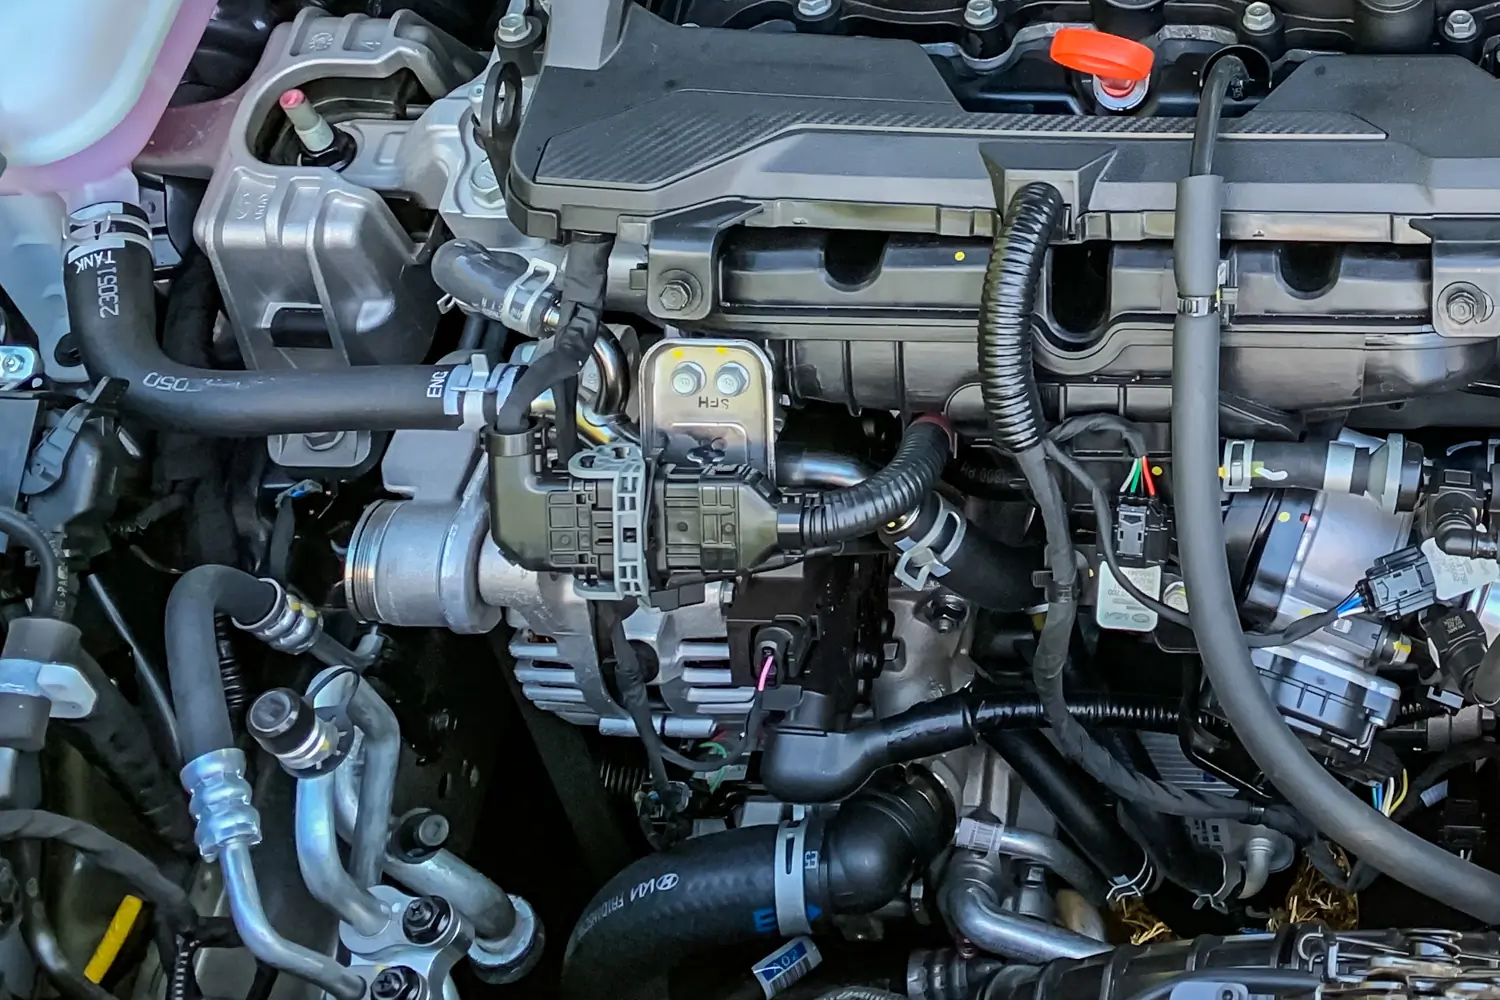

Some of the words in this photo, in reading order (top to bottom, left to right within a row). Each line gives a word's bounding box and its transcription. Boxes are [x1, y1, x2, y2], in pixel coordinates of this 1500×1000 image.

[74, 250, 117, 275] TANK
[425, 370, 450, 398] ENG
[698, 395, 730, 410] SFH
